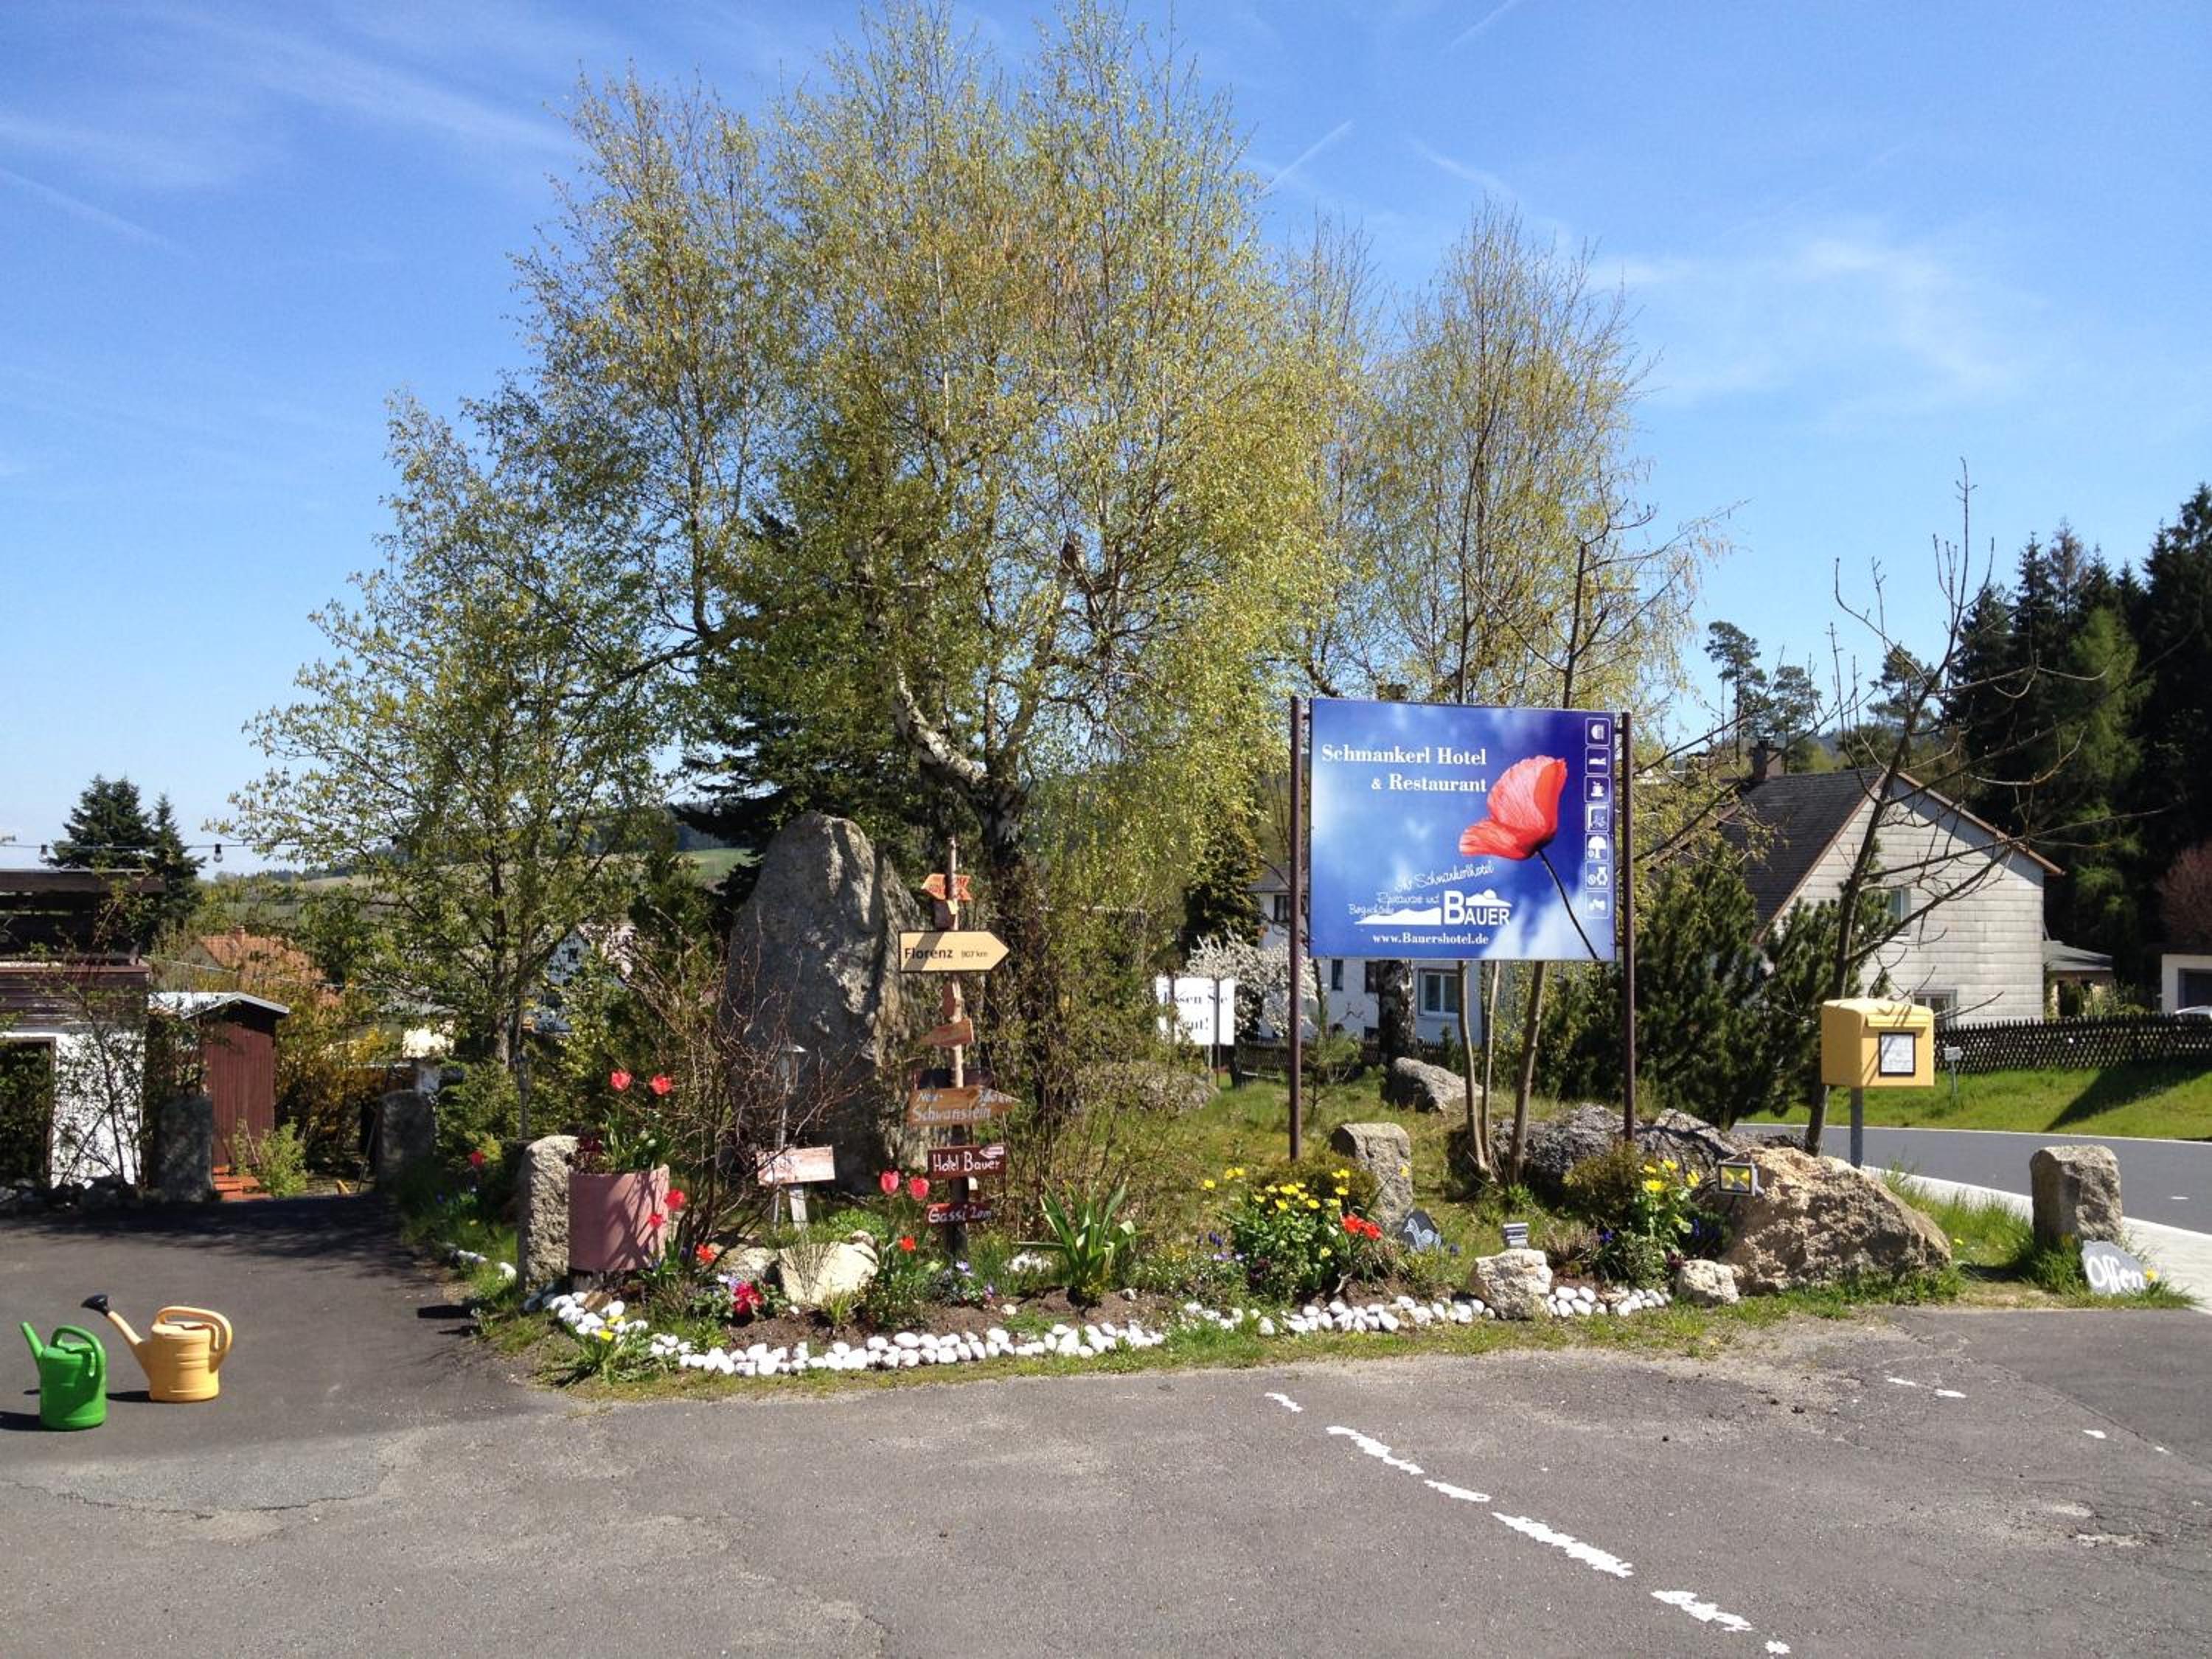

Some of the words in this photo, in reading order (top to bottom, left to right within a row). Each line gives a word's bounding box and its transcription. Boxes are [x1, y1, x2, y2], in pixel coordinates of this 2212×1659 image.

[1321, 744, 1430, 764] Schmankerl
[1437, 747, 1486, 765] Hotel
[1371, 778, 1382, 790] &
[1389, 773, 1486, 793] Restaurant
[1372, 932, 1489, 945] www.Bauershotel.de
[904, 947, 953, 959] Florenz
[933, 1154, 959, 1172] Hotel
[964, 1151, 1001, 1172] Bauer
[929, 1205, 967, 1223] Gassi
[2086, 1255, 2144, 1293] Offen
